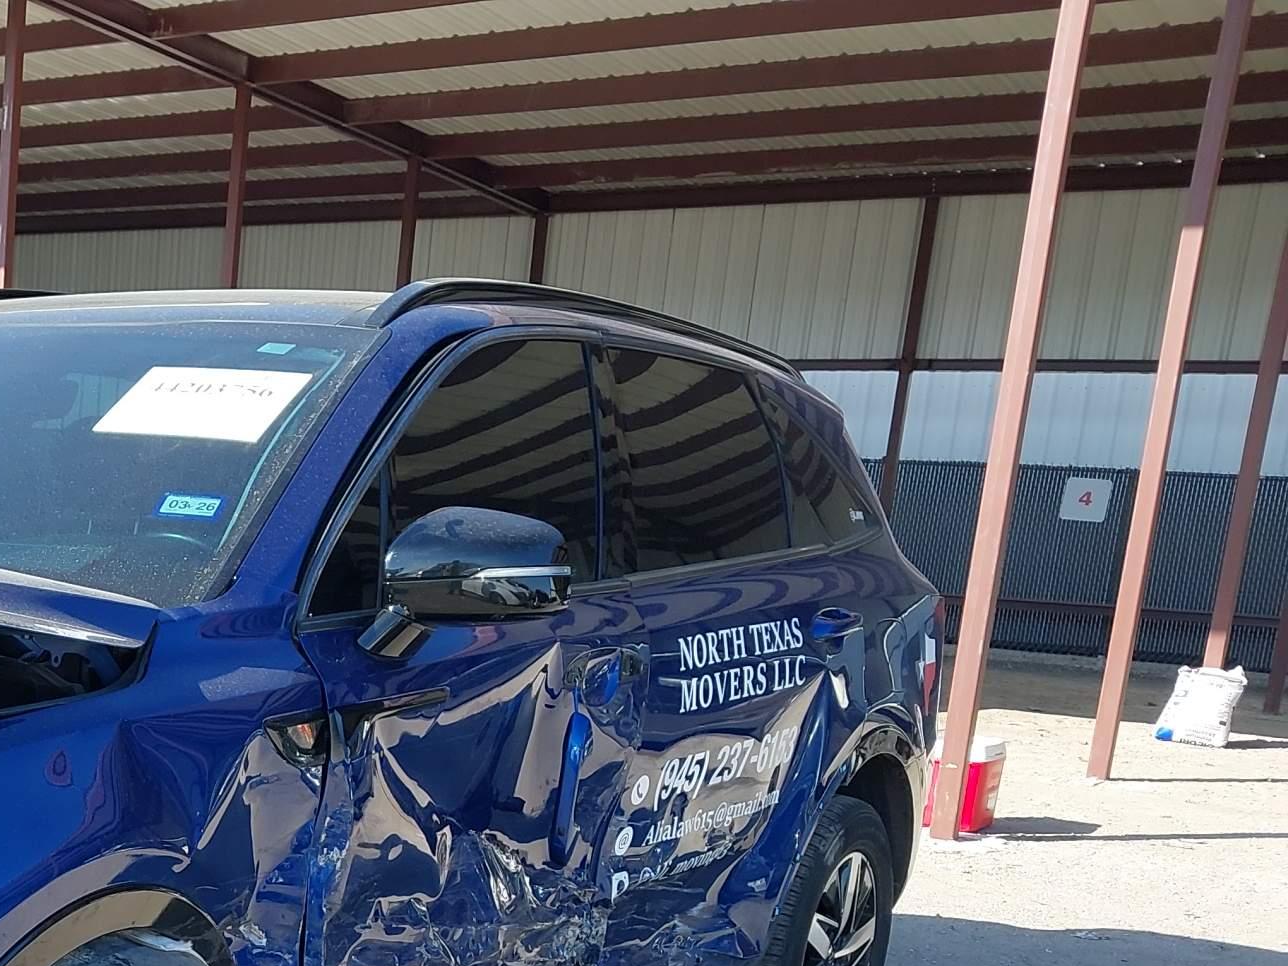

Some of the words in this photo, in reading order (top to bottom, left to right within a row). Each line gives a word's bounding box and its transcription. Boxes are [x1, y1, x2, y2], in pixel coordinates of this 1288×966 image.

[168, 499, 189, 510] 03
[195, 502, 217, 512] 26
[1078, 490, 1093, 506] 4
[678, 627, 747, 672] NORTH
[748, 617, 804, 657] TEXAS
[679, 664, 768, 714] MOVERS
[773, 655, 806, 692] LLC
[653, 749, 710, 811] (945)
[708, 726, 798, 786] 237-6153
